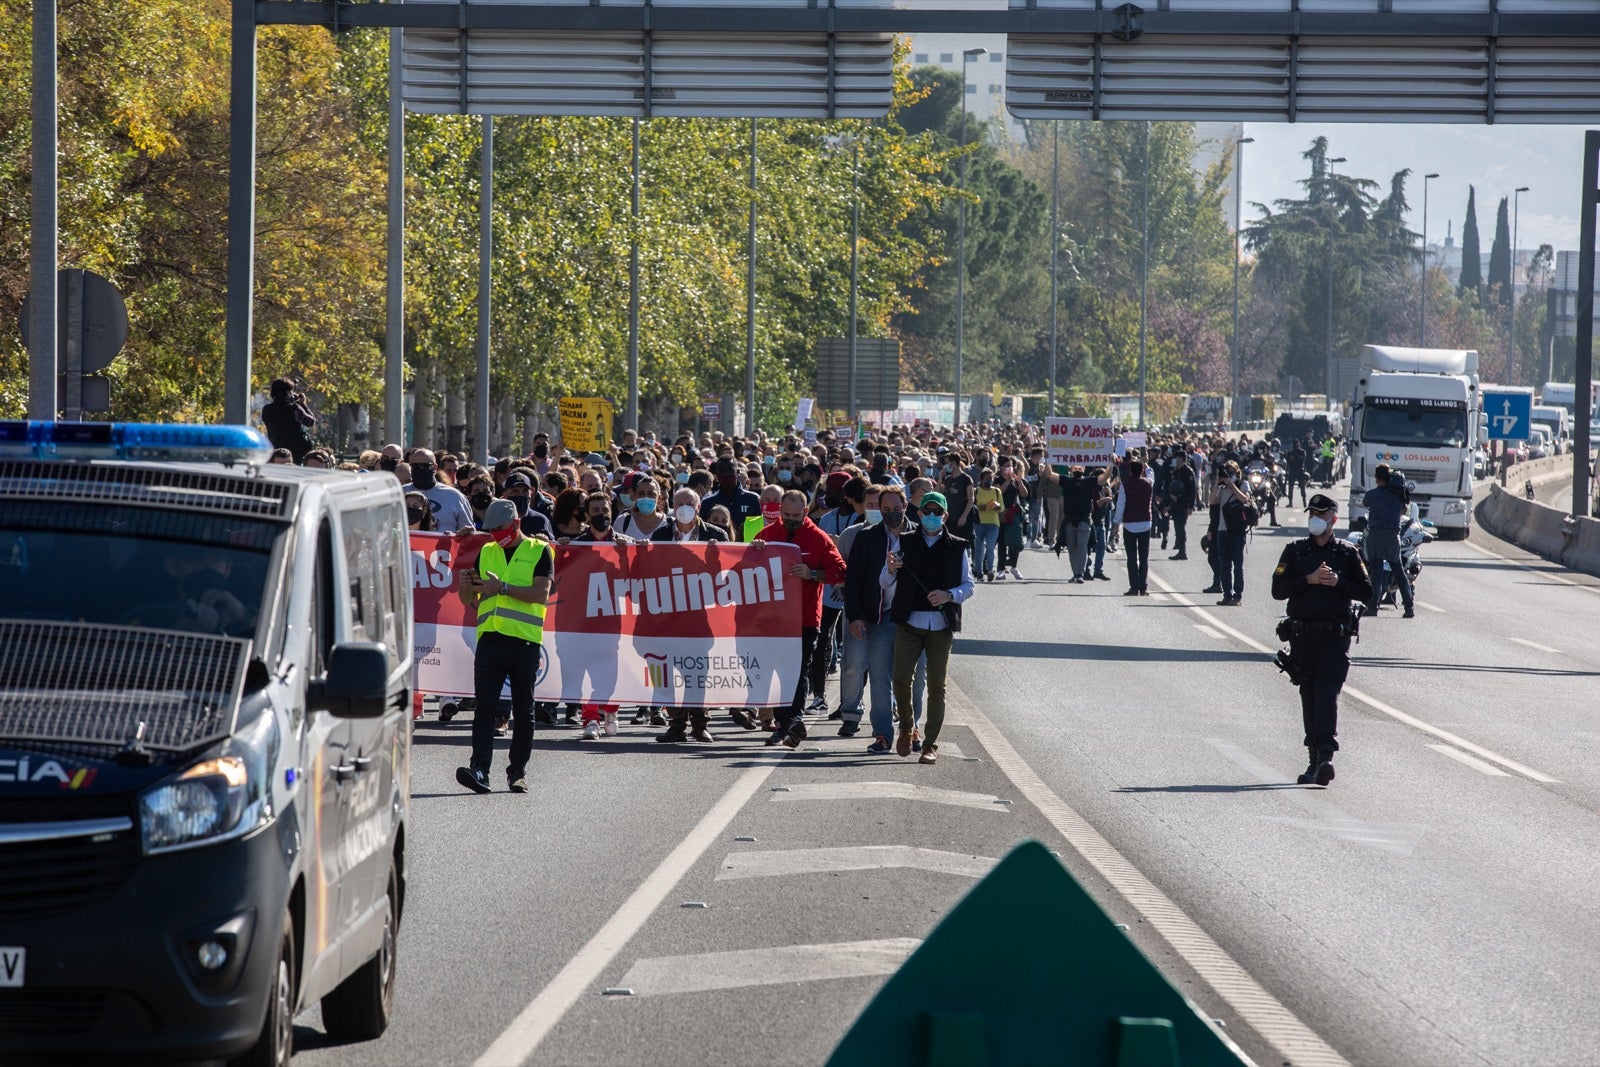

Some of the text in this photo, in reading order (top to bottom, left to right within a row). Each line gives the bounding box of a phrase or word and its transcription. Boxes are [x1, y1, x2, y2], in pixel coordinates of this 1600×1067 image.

[1420, 399, 1433, 407] LOS
[1050, 424, 1113, 439] NO AYUDAS
[1404, 453, 1451, 463] LOS LLANOS
[586, 556, 785, 618] Arruinan!
[673, 652, 761, 670] HOSTELERÍA
[674, 671, 754, 689] DE ESPAÑA
